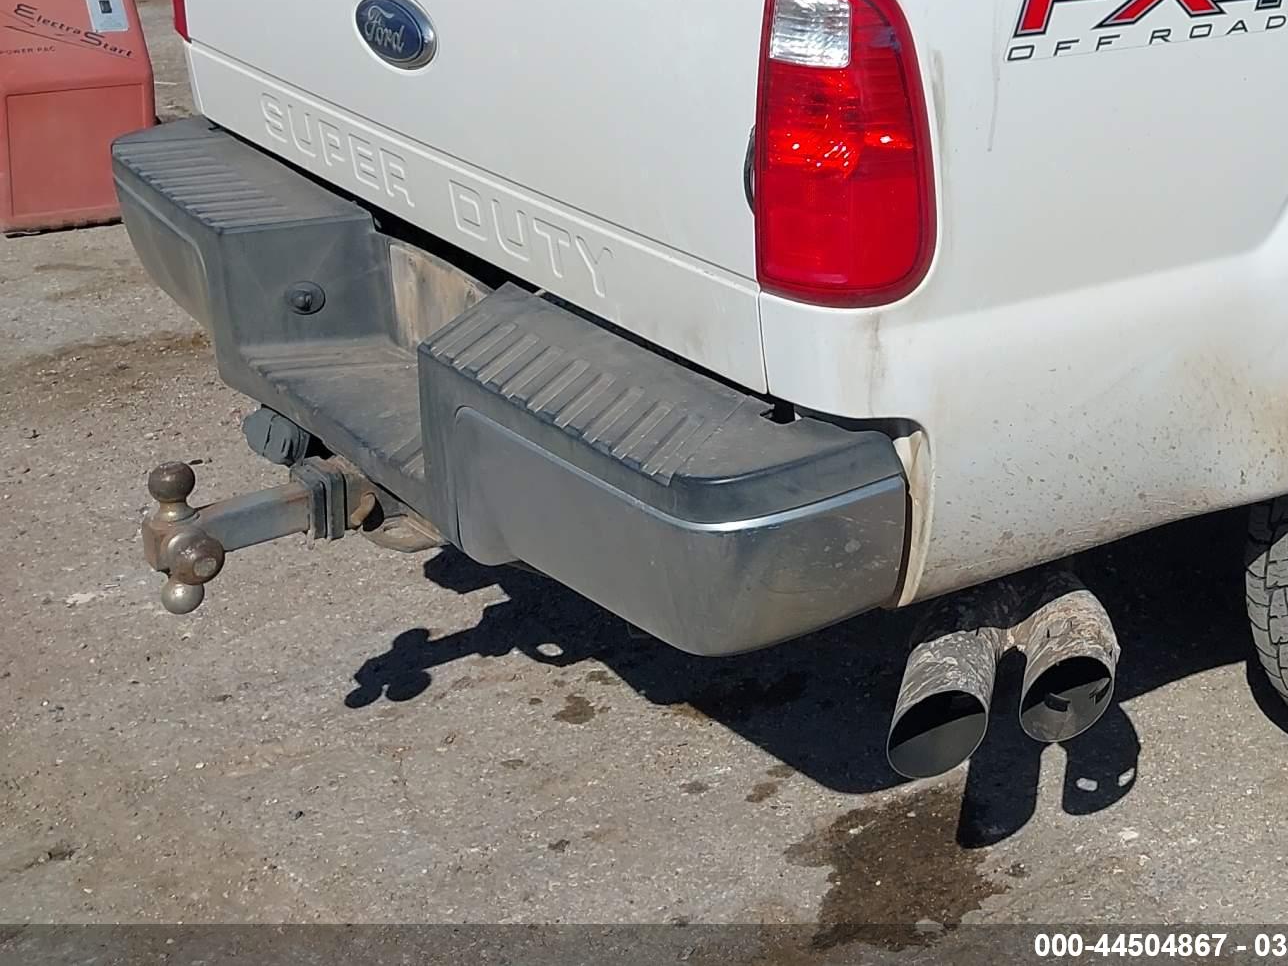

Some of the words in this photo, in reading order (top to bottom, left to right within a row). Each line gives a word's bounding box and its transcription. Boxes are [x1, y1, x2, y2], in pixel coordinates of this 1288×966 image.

[364, 5, 405, 53] Ford
[260, 92, 414, 208] SUPER
[449, 179, 615, 298] DUTY
